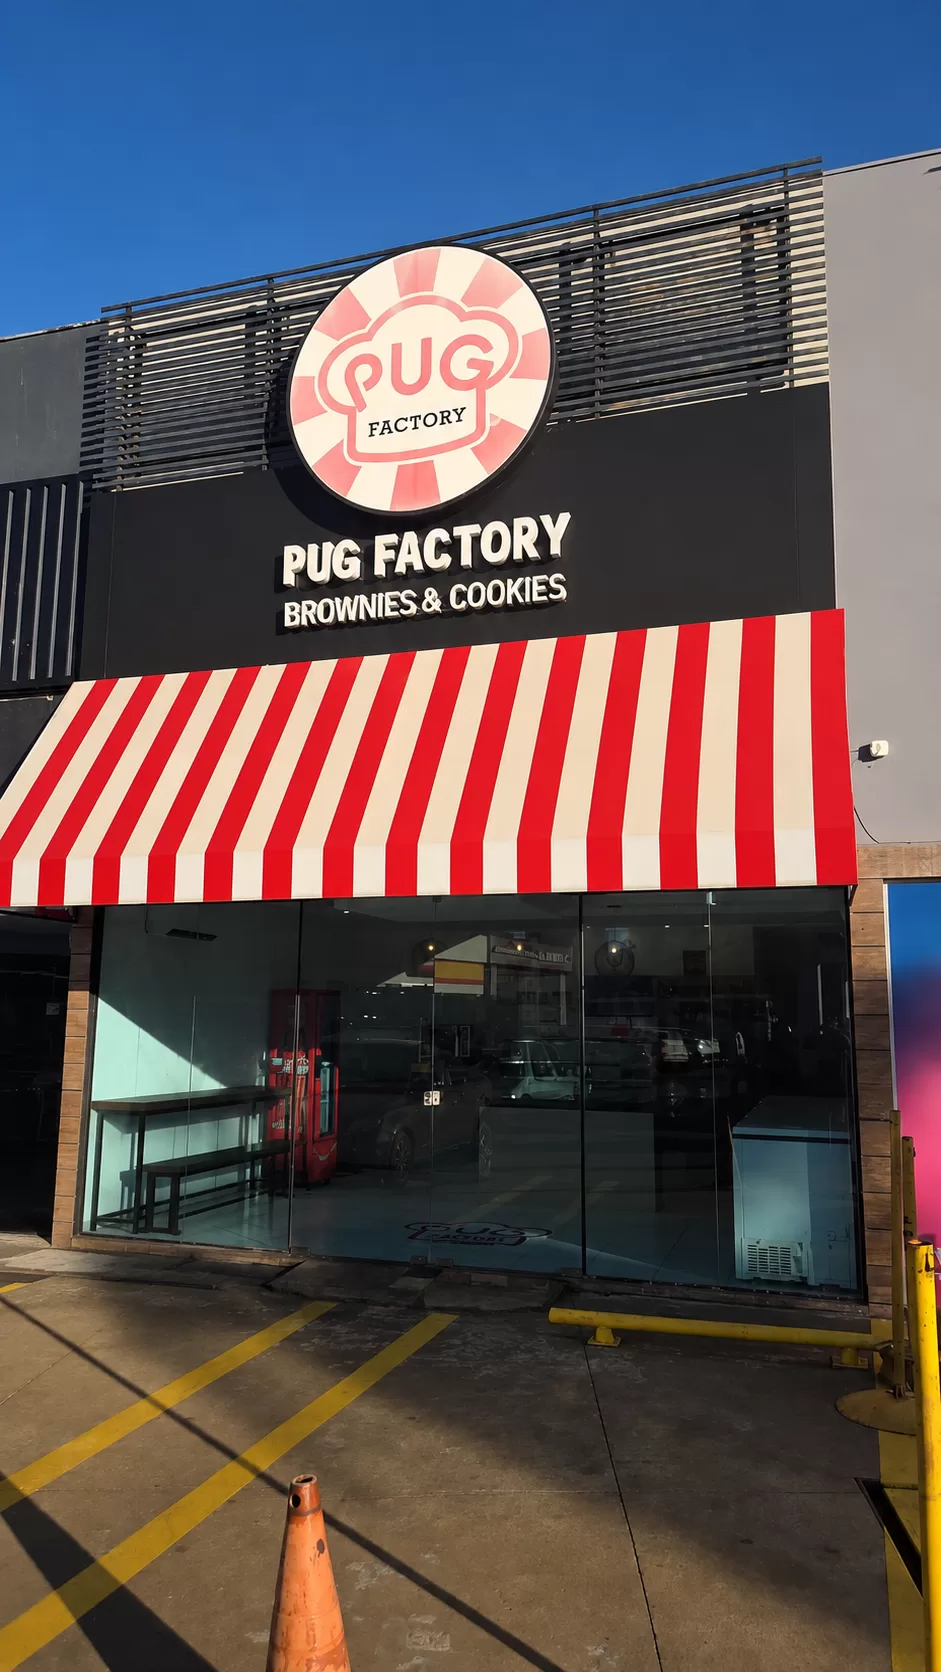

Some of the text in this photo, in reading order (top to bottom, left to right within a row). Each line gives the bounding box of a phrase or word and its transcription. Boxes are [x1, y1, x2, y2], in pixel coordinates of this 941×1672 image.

[344, 333, 495, 413] PUG
[368, 406, 467, 438] FACTORY
[282, 511, 572, 588] PUG FACTORY
[283, 572, 568, 629] BROWNIES & COOKIES
